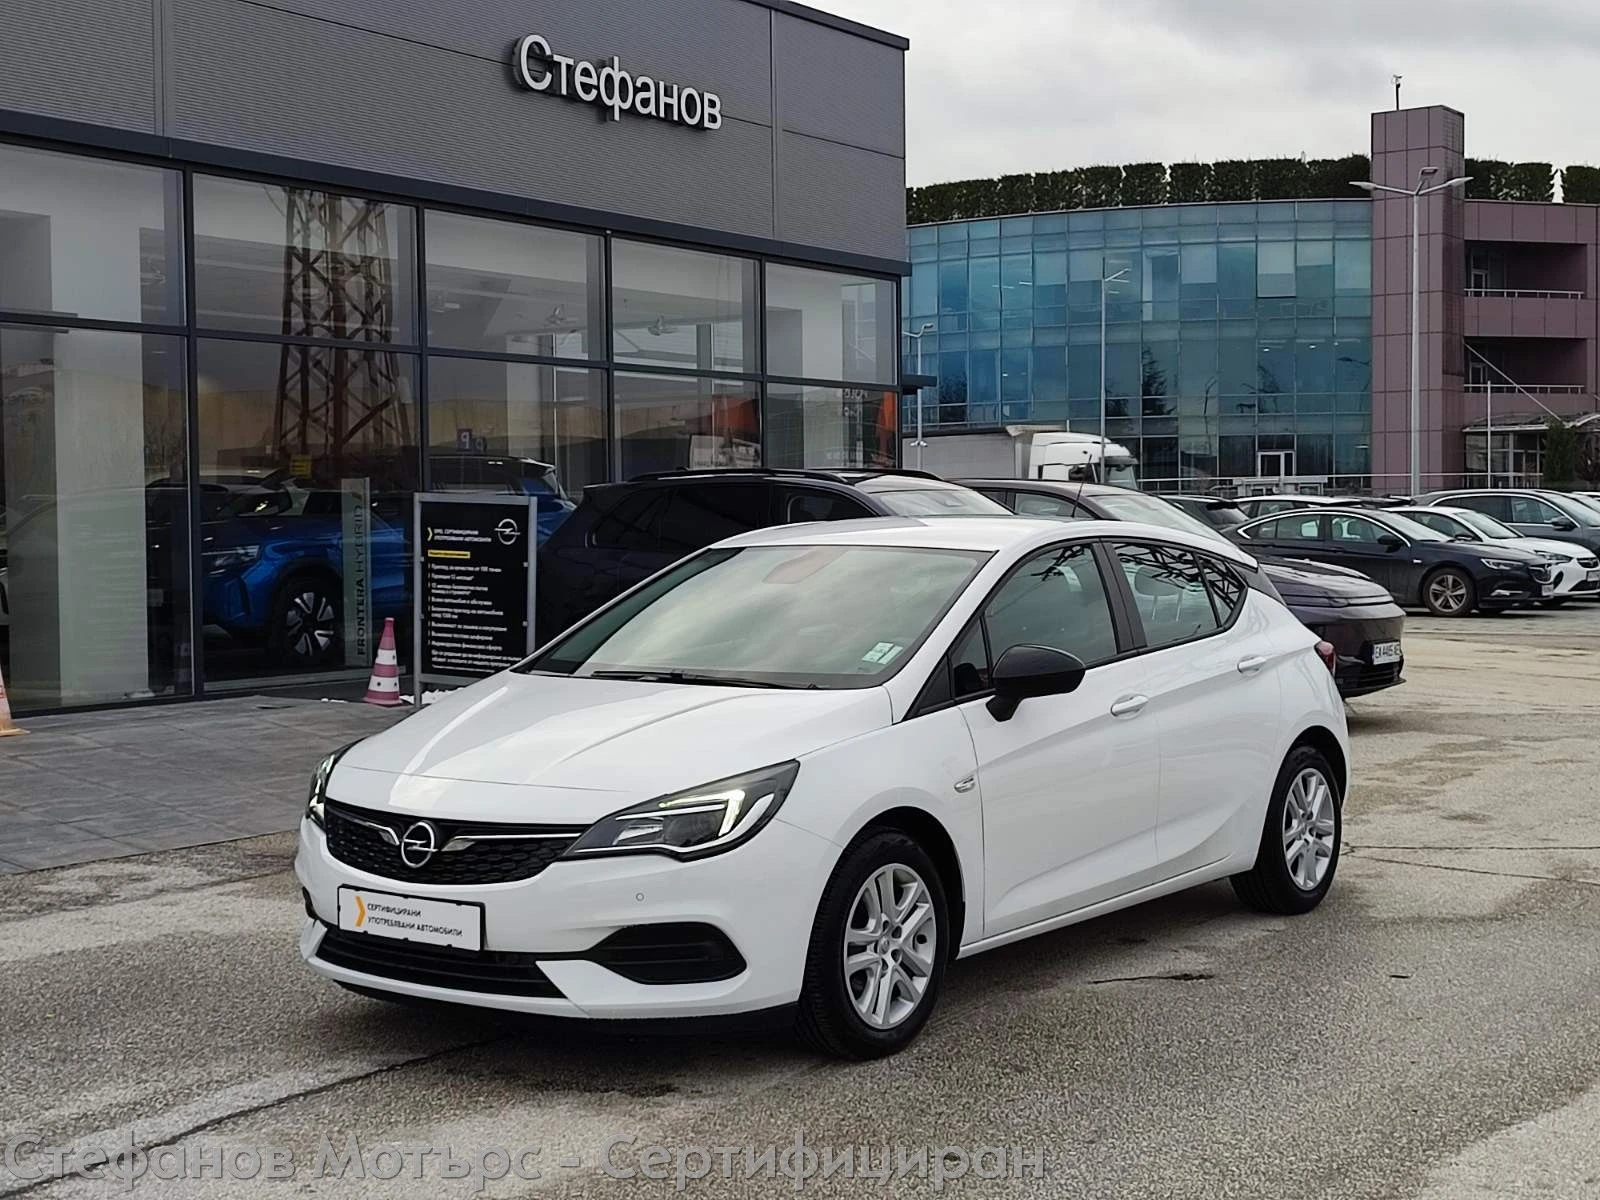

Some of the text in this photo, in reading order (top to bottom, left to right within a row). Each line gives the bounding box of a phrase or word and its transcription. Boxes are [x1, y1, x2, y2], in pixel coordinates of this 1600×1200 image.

[514, 34, 722, 129] Стефанов
[354, 504, 365, 656] FRONTERA HYBRID
[367, 902, 421, 918] СЕРТИФИЦИРАНИ
[417, 925, 463, 937] АВТОМОБИЛИ
